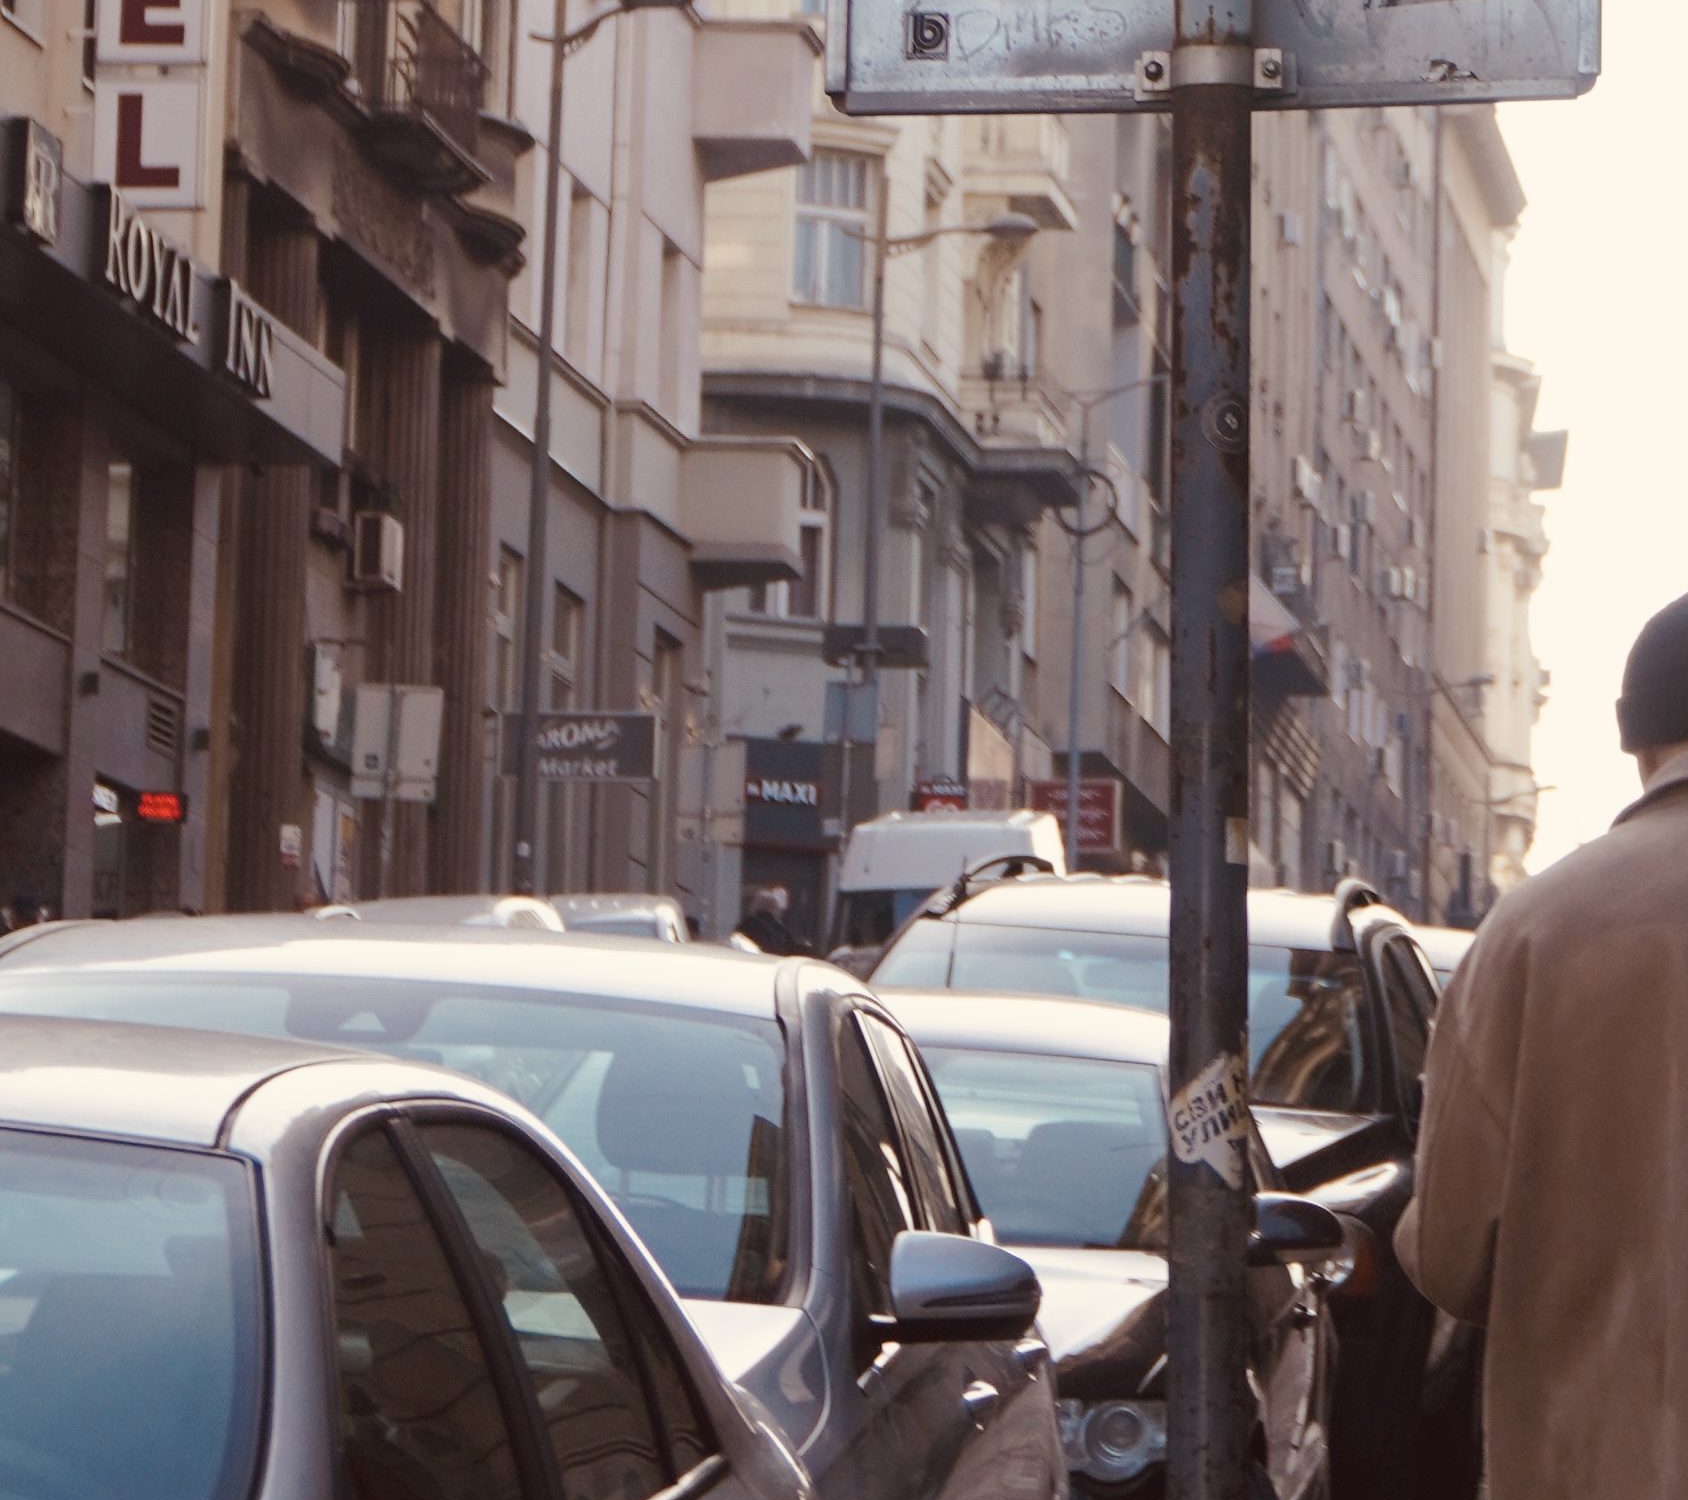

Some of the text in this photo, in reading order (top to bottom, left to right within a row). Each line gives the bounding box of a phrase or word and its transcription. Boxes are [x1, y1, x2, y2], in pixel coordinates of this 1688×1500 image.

[105, 185, 273, 398] ROYAL INN
[537, 757, 617, 777] Market
[762, 780, 817, 806] MAXI
